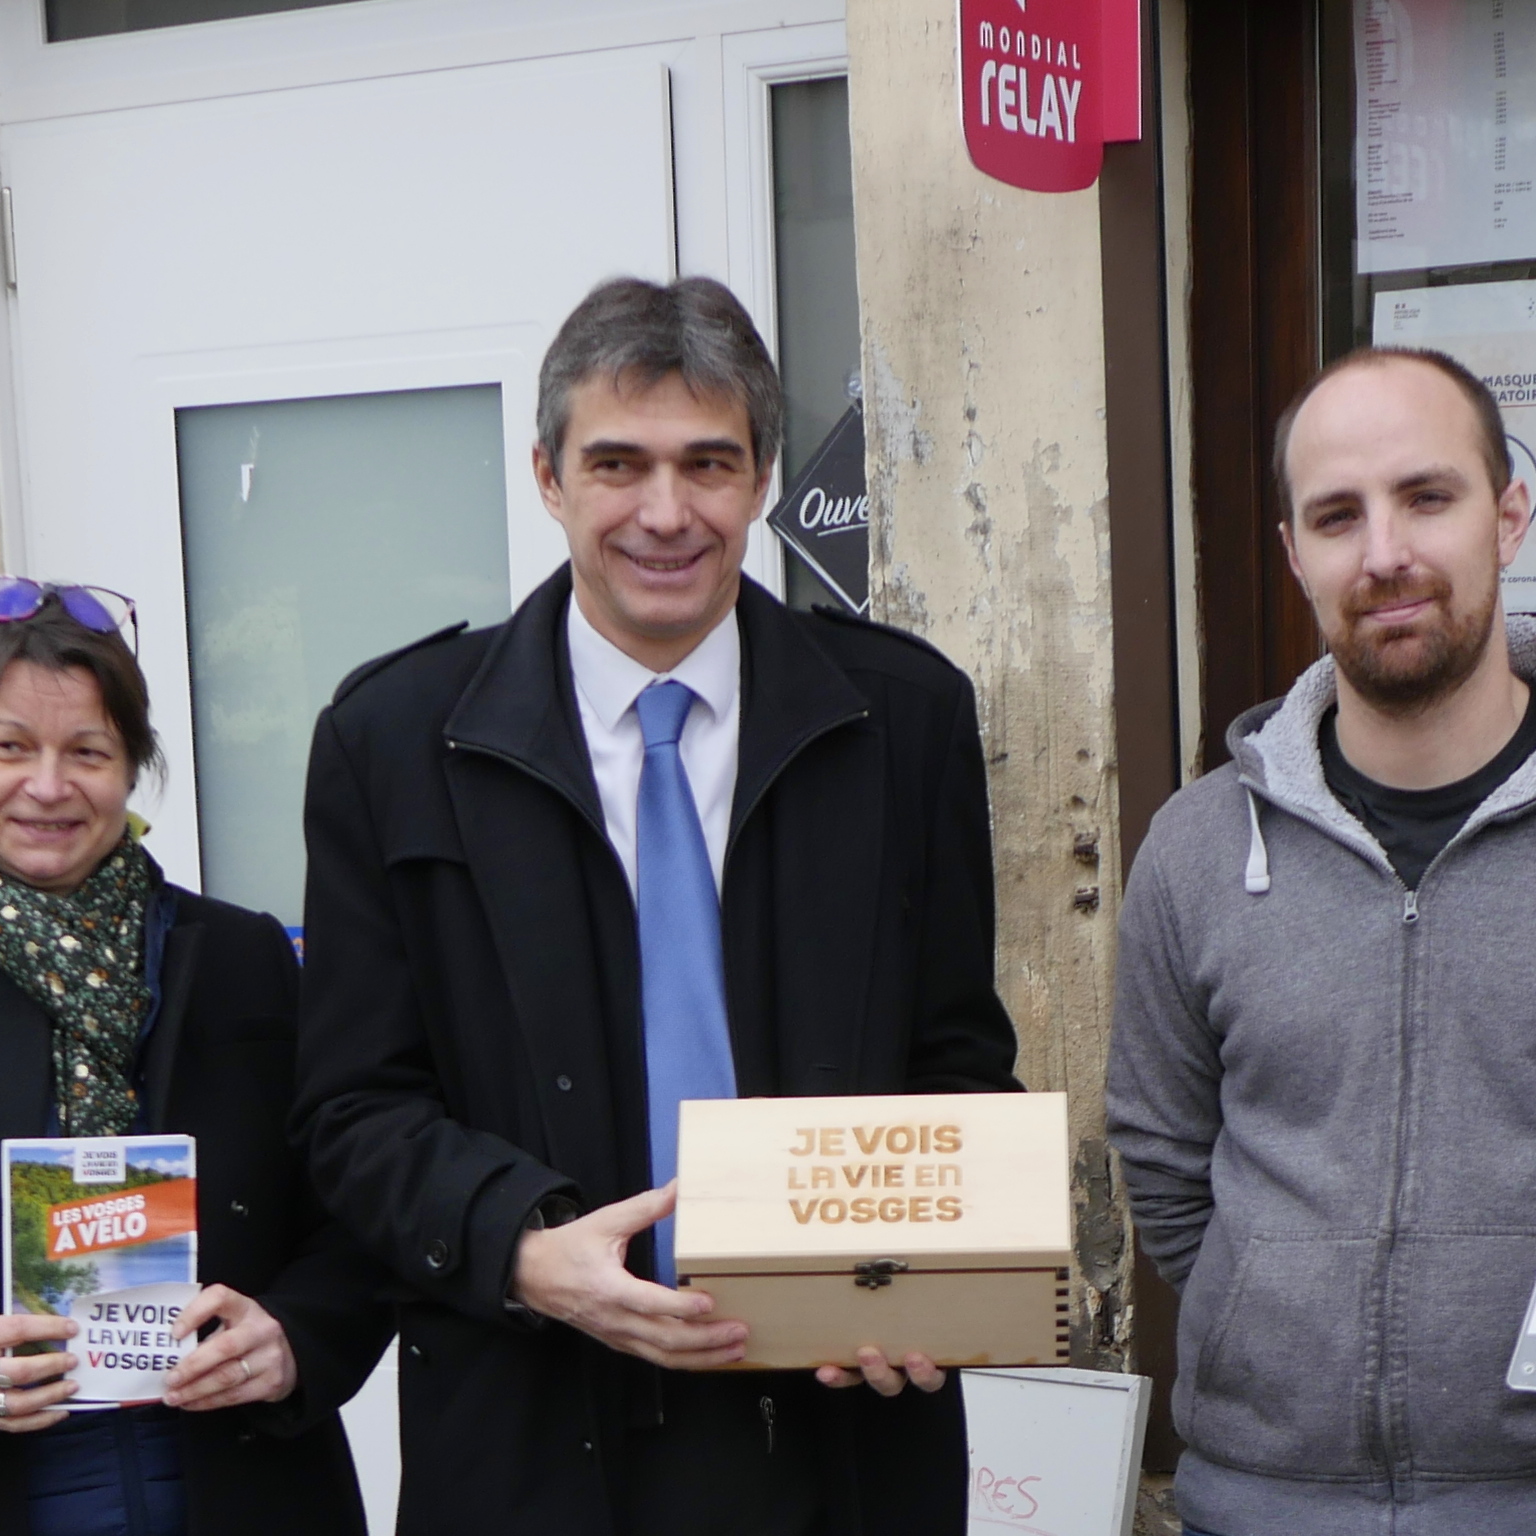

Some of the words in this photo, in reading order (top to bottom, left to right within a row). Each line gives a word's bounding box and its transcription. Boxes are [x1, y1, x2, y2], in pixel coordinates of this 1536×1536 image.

[979, 20, 1081, 70] MONDIAL
[981, 59, 1082, 143] RELAY
[788, 1128, 847, 1156] JE
[852, 1124, 963, 1155] VOIS
[787, 1166, 837, 1190] LA
[841, 1164, 905, 1188] VIE
[915, 1163, 963, 1187] EN
[53, 1207, 81, 1226] LES
[82, 1194, 145, 1221] VOSGES
[789, 1196, 963, 1225] VOSGES
[78, 1211, 147, 1247] VÉLO
[89, 1303, 119, 1322] JE
[124, 1304, 184, 1326] VOIS
[88, 1328, 113, 1345] LA
[116, 1330, 150, 1347] VIE
[88, 1351, 181, 1371] VOSGES
[970, 1464, 1041, 1519] IRES
